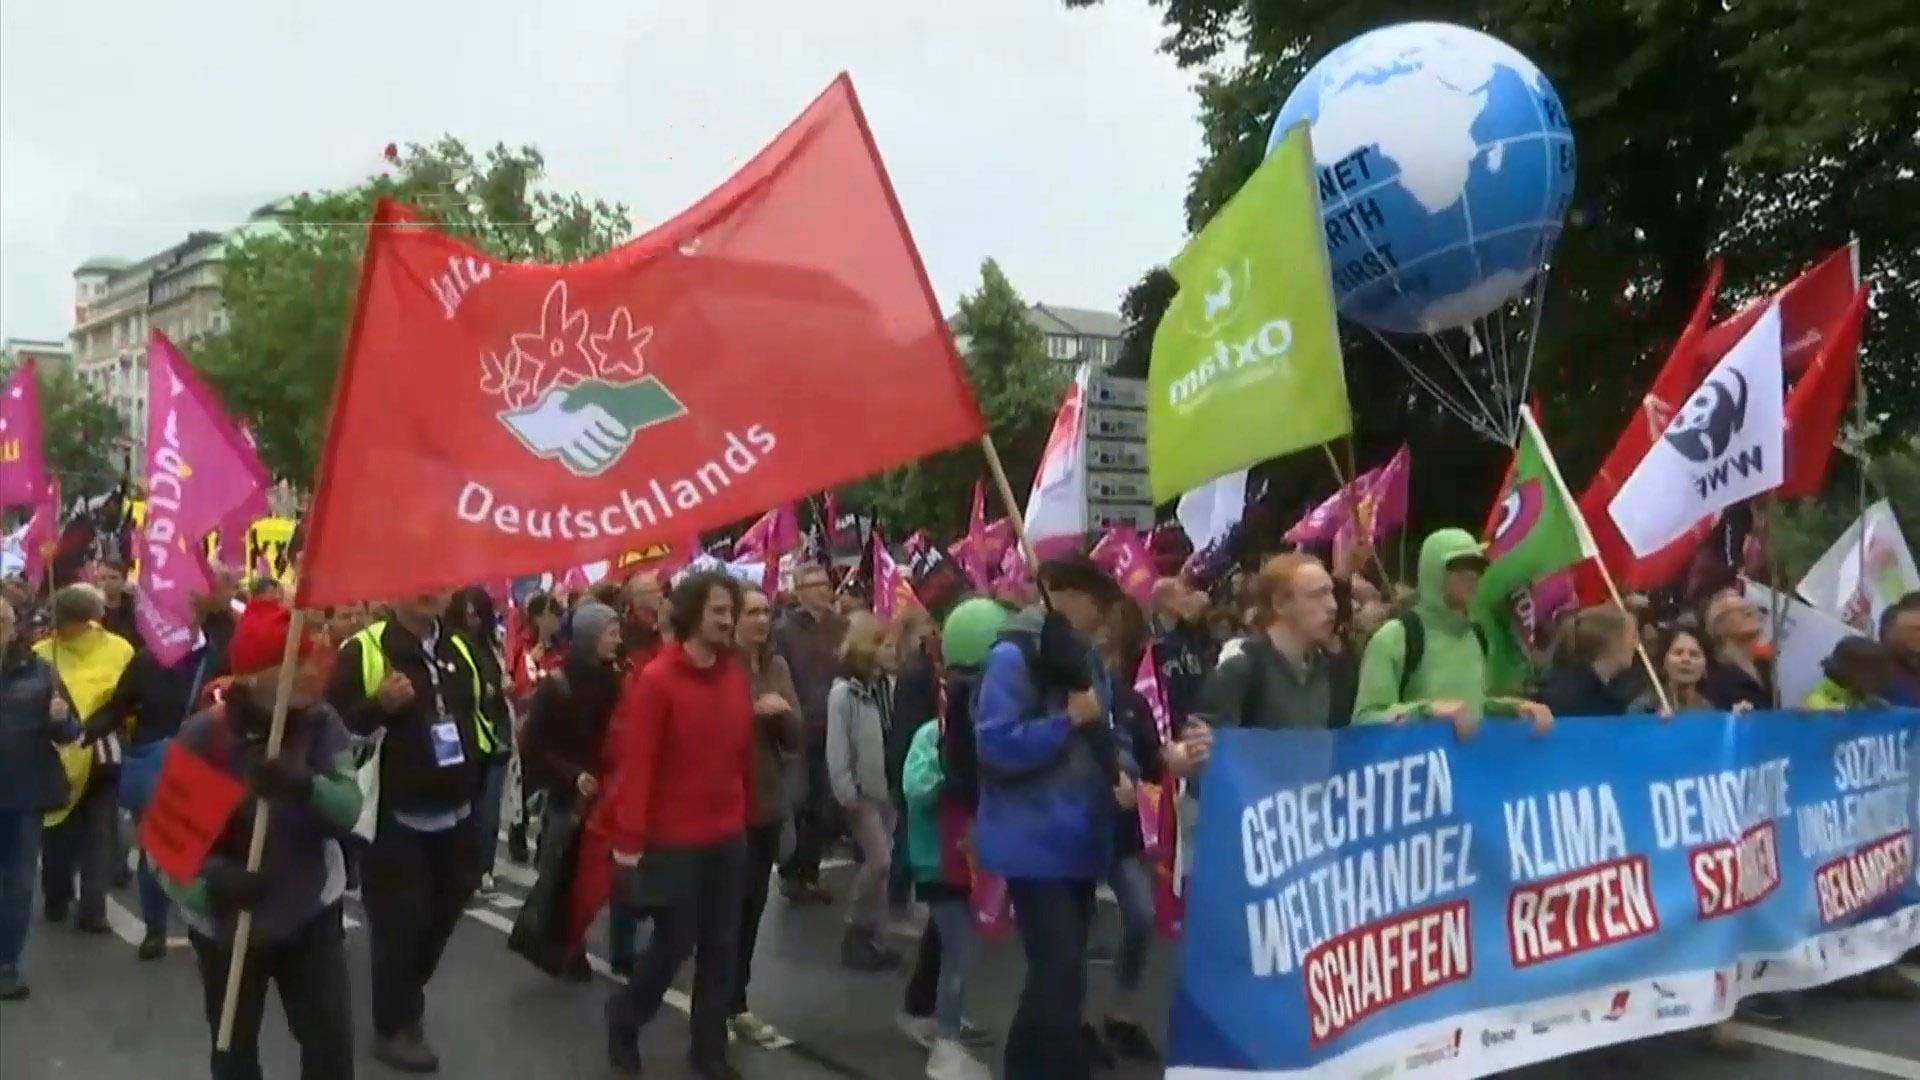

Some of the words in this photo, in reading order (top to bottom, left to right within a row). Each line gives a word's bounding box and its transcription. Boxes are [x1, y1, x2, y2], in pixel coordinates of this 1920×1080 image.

[457, 423, 777, 540] Deutschlands
[1241, 747, 1453, 887] GERECHTEN
[1503, 784, 1627, 880] KLIMA
[1246, 822, 1477, 978] WELTHANDEL
[1510, 861, 1655, 963] RETTEN
[1307, 905, 1469, 1040] SCHAFFEN
